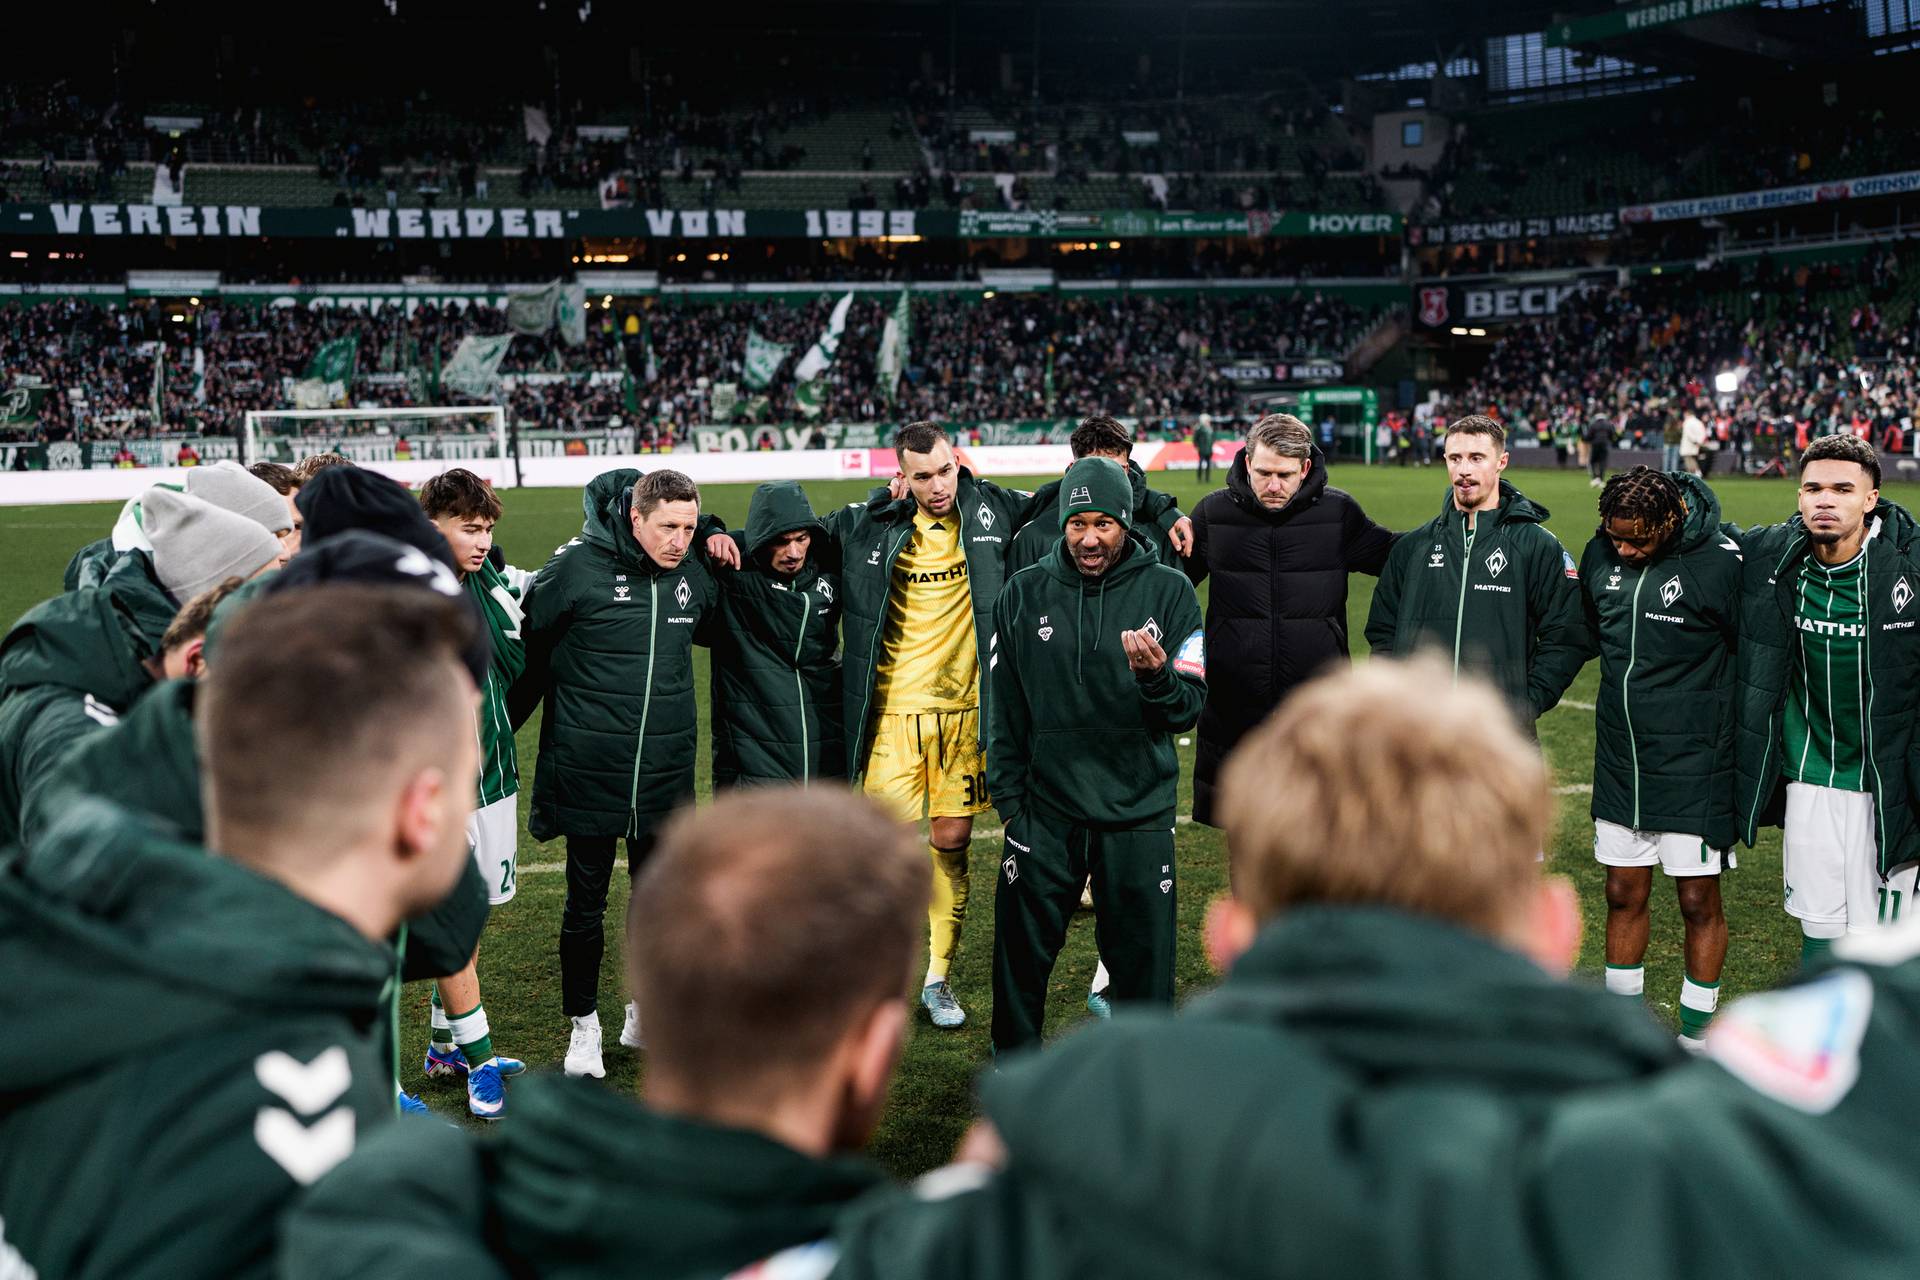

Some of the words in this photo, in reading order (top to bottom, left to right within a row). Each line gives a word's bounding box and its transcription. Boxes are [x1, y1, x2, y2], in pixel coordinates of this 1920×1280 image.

[1626, 1, 1687, 30] WERDER
[645, 209, 745, 237] VON
[805, 209, 916, 237] 1899
[1308, 214, 1392, 233] HOYER
[1555, 212, 1615, 234] HAUSE
[901, 560, 968, 583] MATTH
[1794, 615, 1866, 637] ATTH
[962, 771, 988, 806] 30
[1877, 887, 1903, 925] 11
